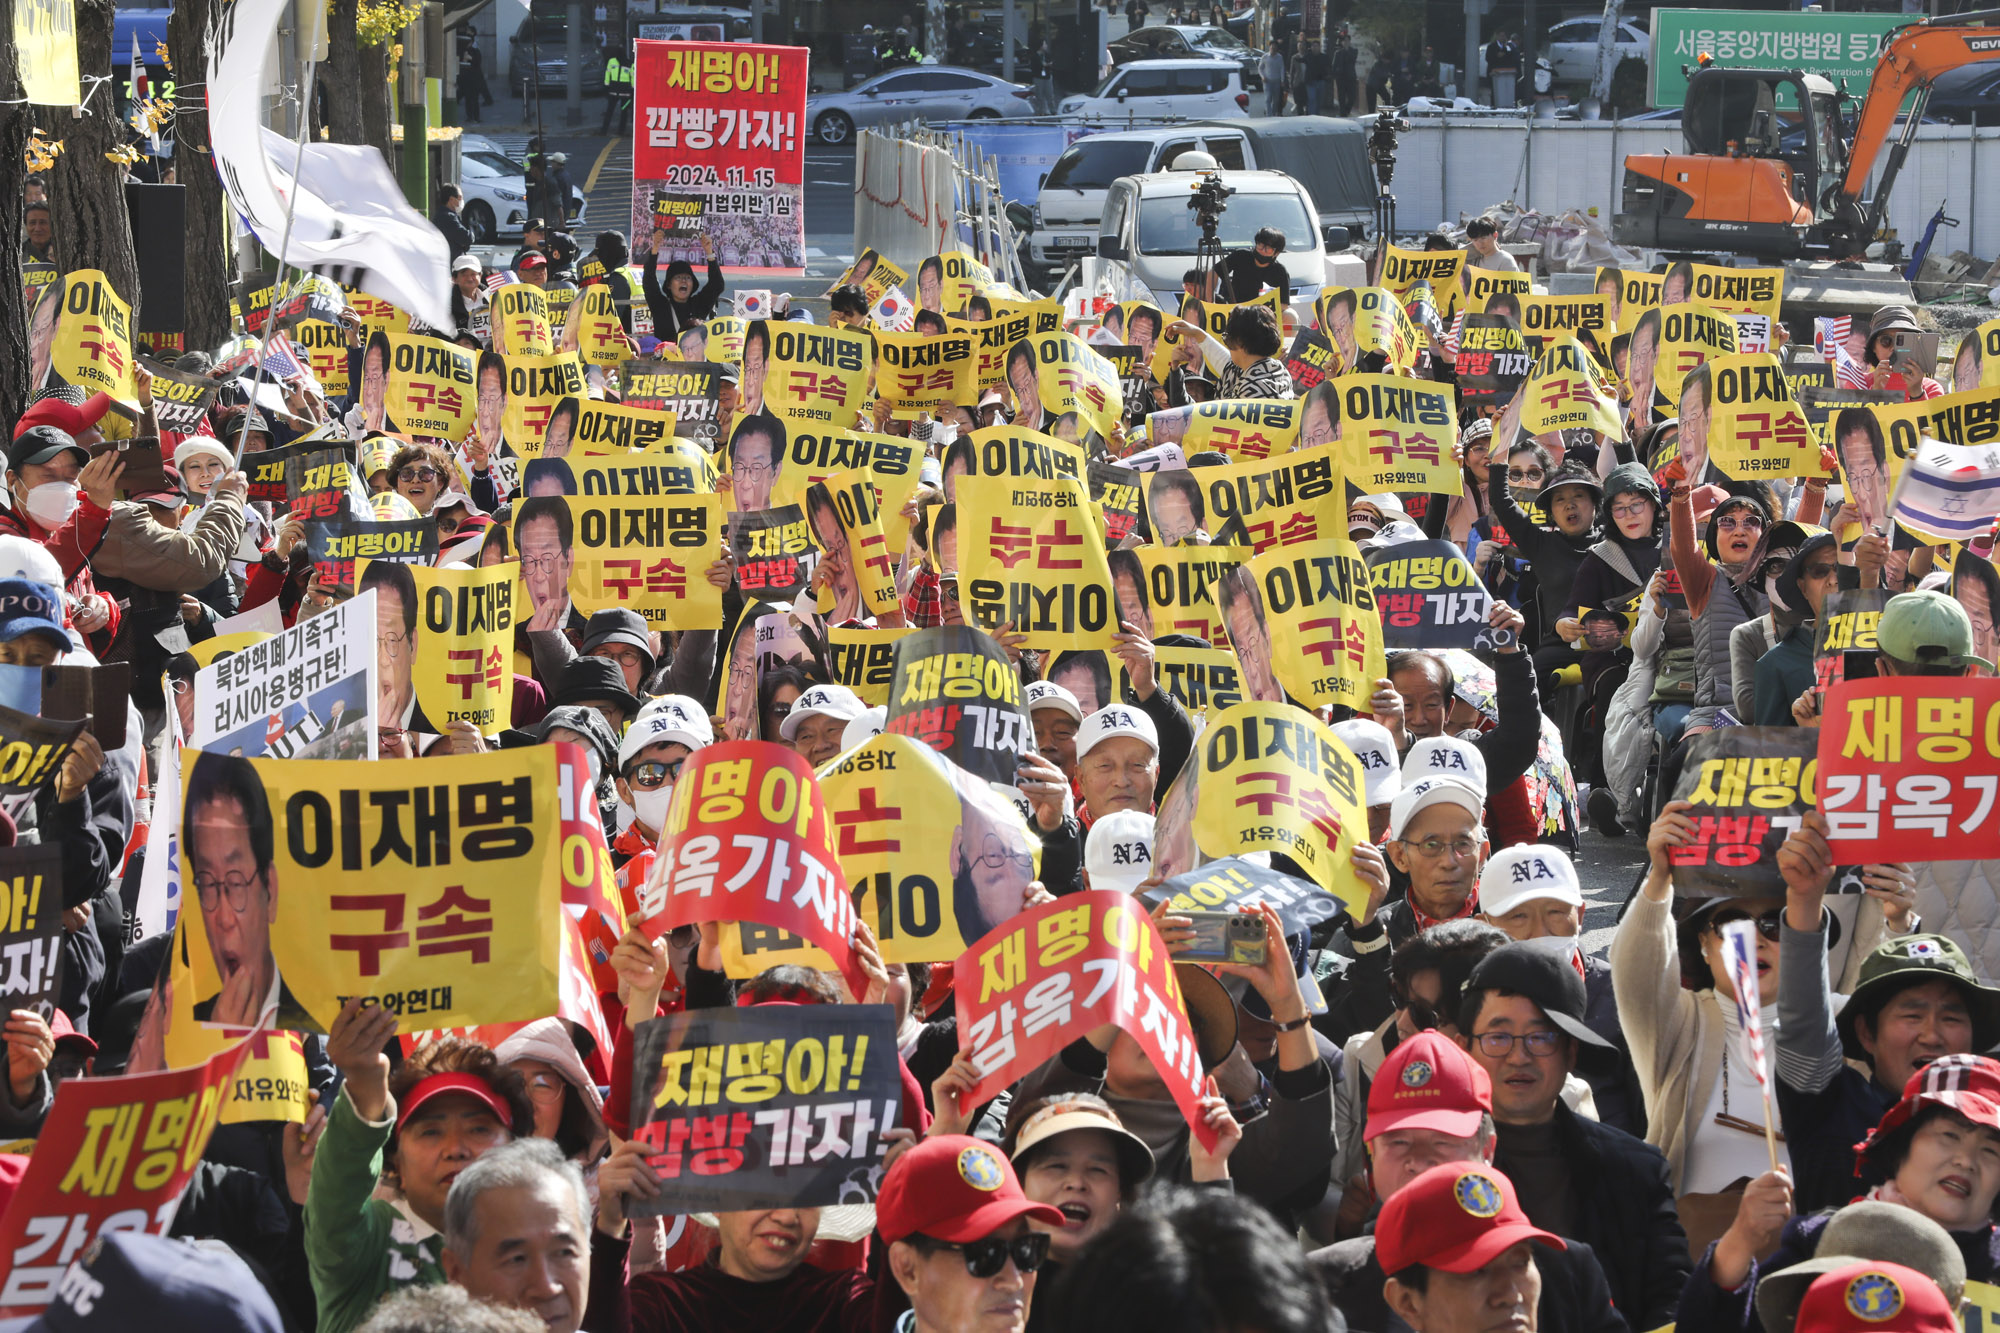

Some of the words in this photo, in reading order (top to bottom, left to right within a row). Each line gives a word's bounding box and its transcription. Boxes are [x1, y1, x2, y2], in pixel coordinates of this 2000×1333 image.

[1674, 29, 1841, 61] 서울중앙지방법원
[667, 50, 780, 94] 재명아!
[646, 107, 796, 151] 깜빵가자!
[657, 200, 702, 215] 재명아!
[767, 195, 790, 215] 1심
[872, 264, 903, 290] 이재명
[1386, 257, 1458, 283] 이재명
[1697, 273, 1775, 302] 이재명
[68, 281, 128, 343] 이재명
[352, 299, 395, 320] 구속
[504, 290, 546, 319] 이재명
[1361, 291, 1415, 352] 이재명
[1525, 303, 1604, 331] 이재명
[516, 319, 547, 346] 구속
[593, 322, 627, 349] 구속
[1371, 315, 1405, 364] 구속
[1665, 312, 1736, 353] 이재명
[80, 324, 124, 379] 구속
[395, 344, 474, 385] 이재명
[776, 331, 865, 372] 이재명
[883, 339, 971, 369] 이재명
[1040, 338, 1113, 386] 이재명
[1531, 345, 1600, 390] 이재명
[77, 366, 116, 391] 자유와연대
[151, 376, 205, 411] 명아!
[322, 382, 349, 391] 유와연대
[511, 360, 583, 398] 이재명
[628, 373, 711, 397] 재명아!
[788, 370, 847, 407] 구속
[898, 368, 954, 397] 구속
[1058, 368, 1107, 413] 구속
[1121, 377, 1144, 399] 자!
[1540, 378, 1600, 411] 구속
[1717, 365, 1790, 404] 이재
[406, 381, 463, 418] 구속
[788, 407, 832, 422] 자유와연대
[1200, 402, 1293, 430] 이재명
[1346, 385, 1450, 426] 이재명
[405, 416, 449, 432] 자유와연대
[524, 405, 551, 435] 구
[579, 410, 664, 447] 이재명
[1540, 411, 1587, 428] 자유와연대
[1736, 411, 1807, 451] 구속
[1890, 398, 2000, 460] 이재명
[791, 434, 912, 476] 이재명
[982, 438, 1079, 482] 이재명
[1209, 426, 1272, 460] 구속
[1369, 429, 1440, 467] 구속
[1373, 472, 1427, 486] 자유와연대
[1739, 457, 1791, 472] 자유와연대
[1012, 489, 1079, 508] 자유와연대
[1210, 456, 1334, 519] 이재명
[325, 530, 425, 558] 재명아!
[580, 507, 708, 549] 이재명
[989, 516, 1084, 570] 구속
[1246, 511, 1318, 551] 구속
[602, 557, 687, 600] 구속
[737, 556, 798, 590] 깜방
[1265, 554, 1374, 614] 이재명
[425, 579, 512, 636] 이재명
[970, 579, 1108, 635] 이재명
[1298, 617, 1366, 673] 구속
[446, 644, 503, 700] 구속
[900, 652, 1020, 707] 재명아!
[1311, 676, 1356, 697] 자유와연대
[800, 691, 831, 708] NA
[1028, 684, 1060, 703] NA
[266, 709, 326, 760] UT!
[1101, 712, 1137, 729] NA
[1207, 716, 1358, 807] 이재명
[1355, 749, 1390, 770] NA
[1429, 749, 1468, 772] NA
[285, 776, 534, 871] 이재명
[1235, 771, 1342, 853] 구속
[1113, 841, 1151, 865] NA
[1239, 826, 1317, 866] 자유와연대
[1512, 858, 1555, 884] NA
[330, 885, 493, 976] 구속
[653, 1035, 869, 1109] 재명아!
